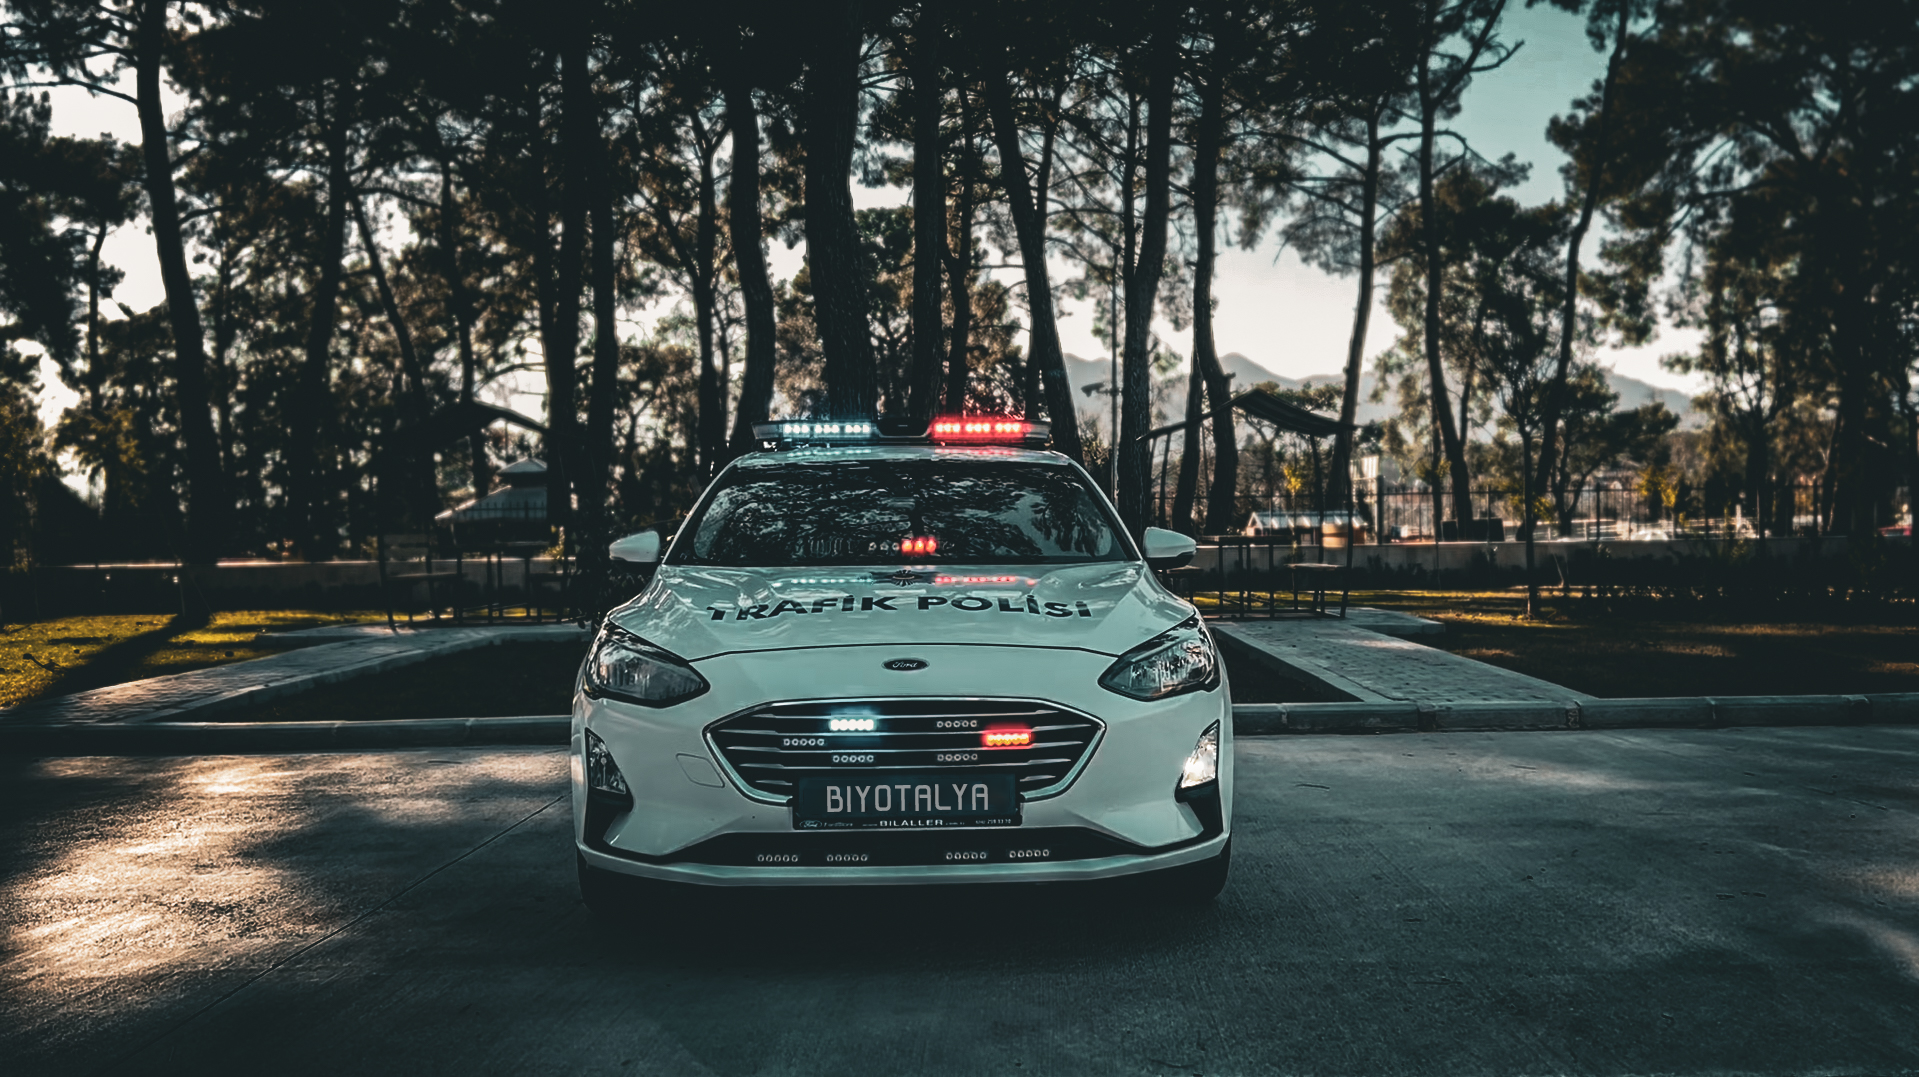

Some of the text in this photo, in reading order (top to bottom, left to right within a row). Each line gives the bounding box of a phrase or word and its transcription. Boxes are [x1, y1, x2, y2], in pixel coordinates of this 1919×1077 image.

[892, 661, 918, 669] Ford
[826, 783, 989, 813] BIYOTALYA
[879, 819, 944, 827] BILALLER
